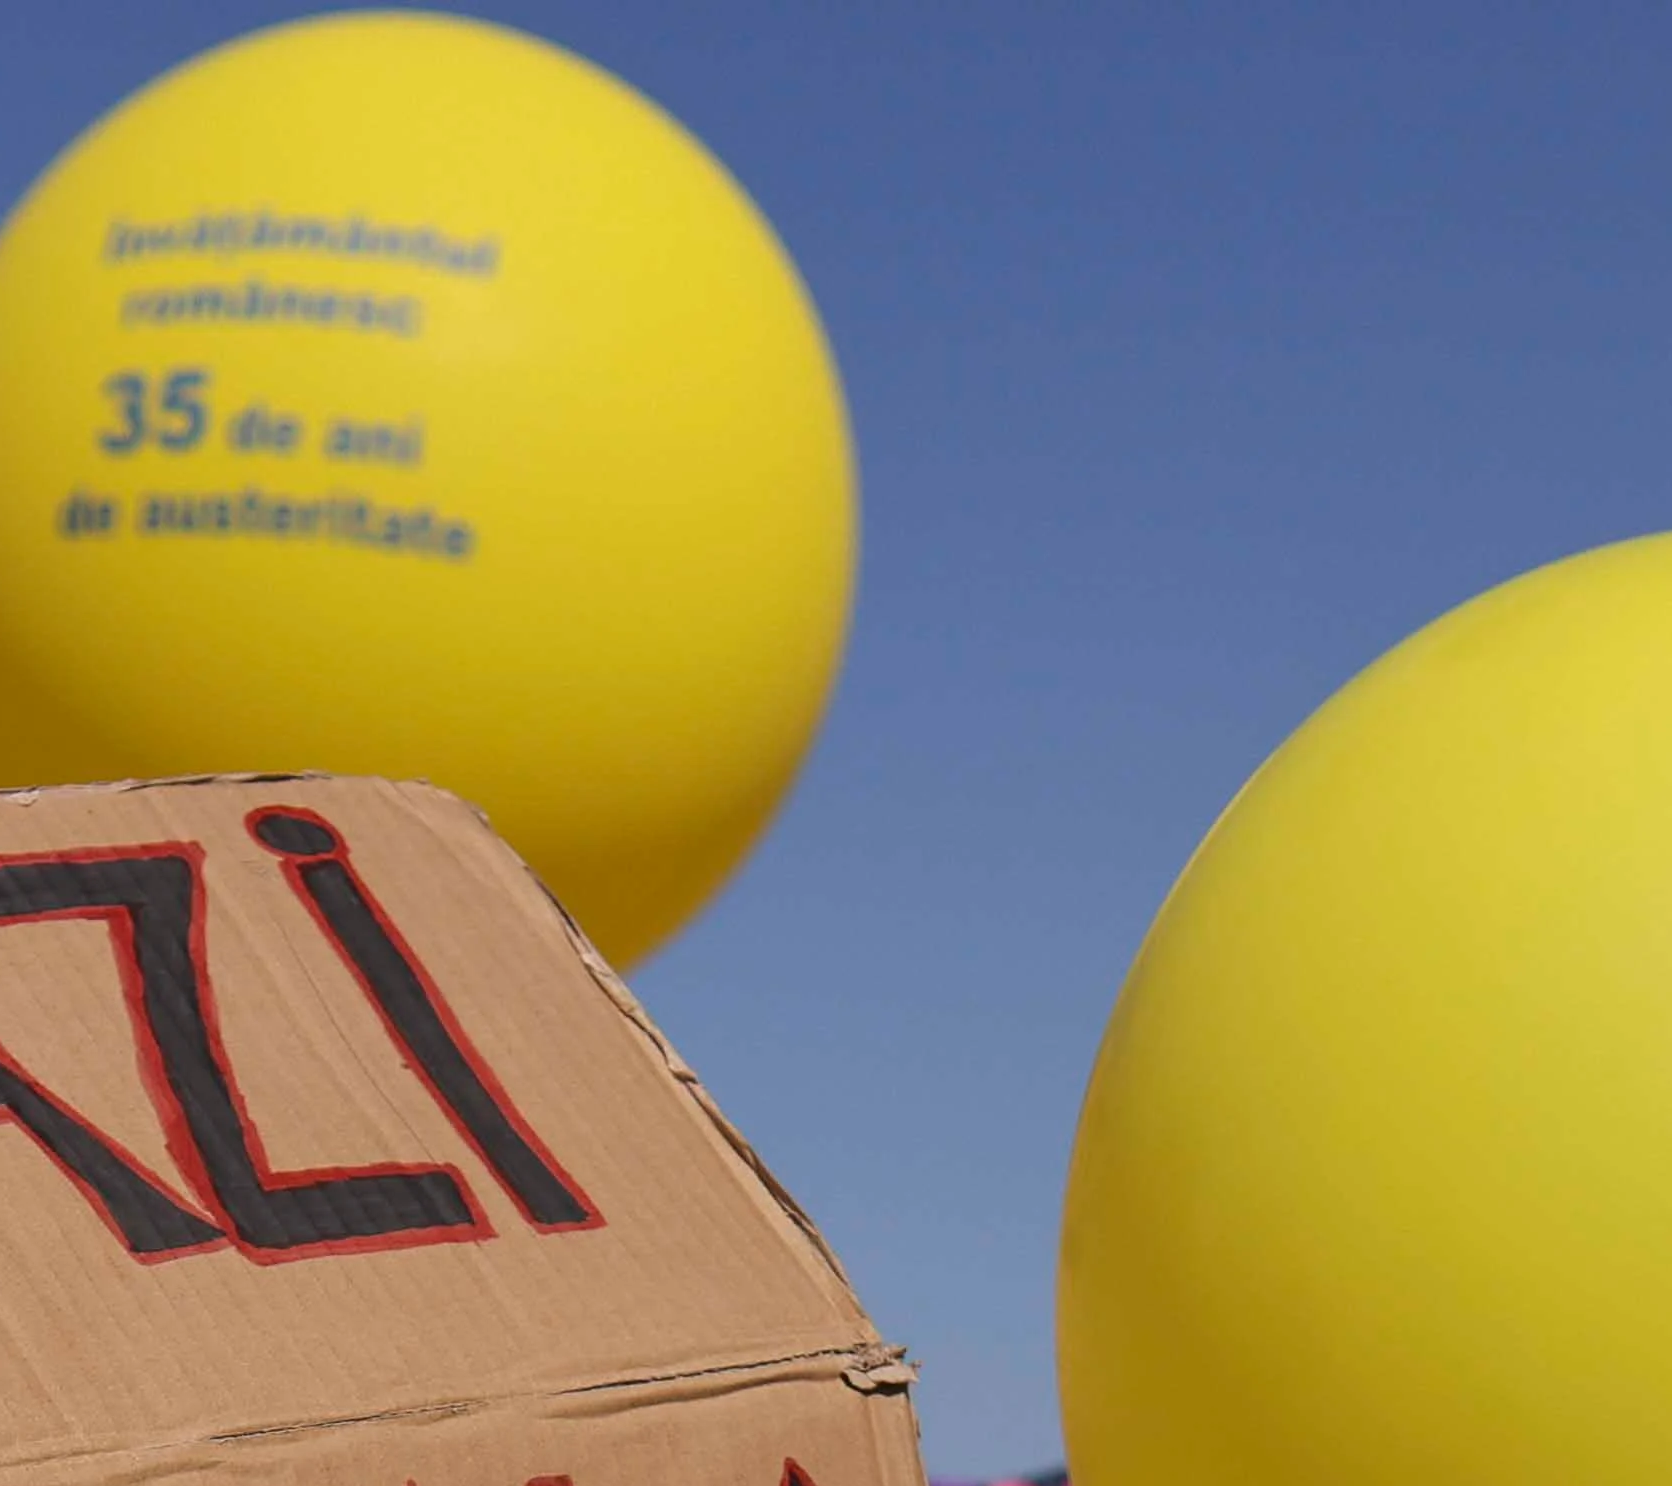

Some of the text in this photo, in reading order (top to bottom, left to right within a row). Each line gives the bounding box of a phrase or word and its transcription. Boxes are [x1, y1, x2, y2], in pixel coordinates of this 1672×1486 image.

[97, 367, 422, 467] 35 de ani
[57, 487, 477, 561] de austeritate
